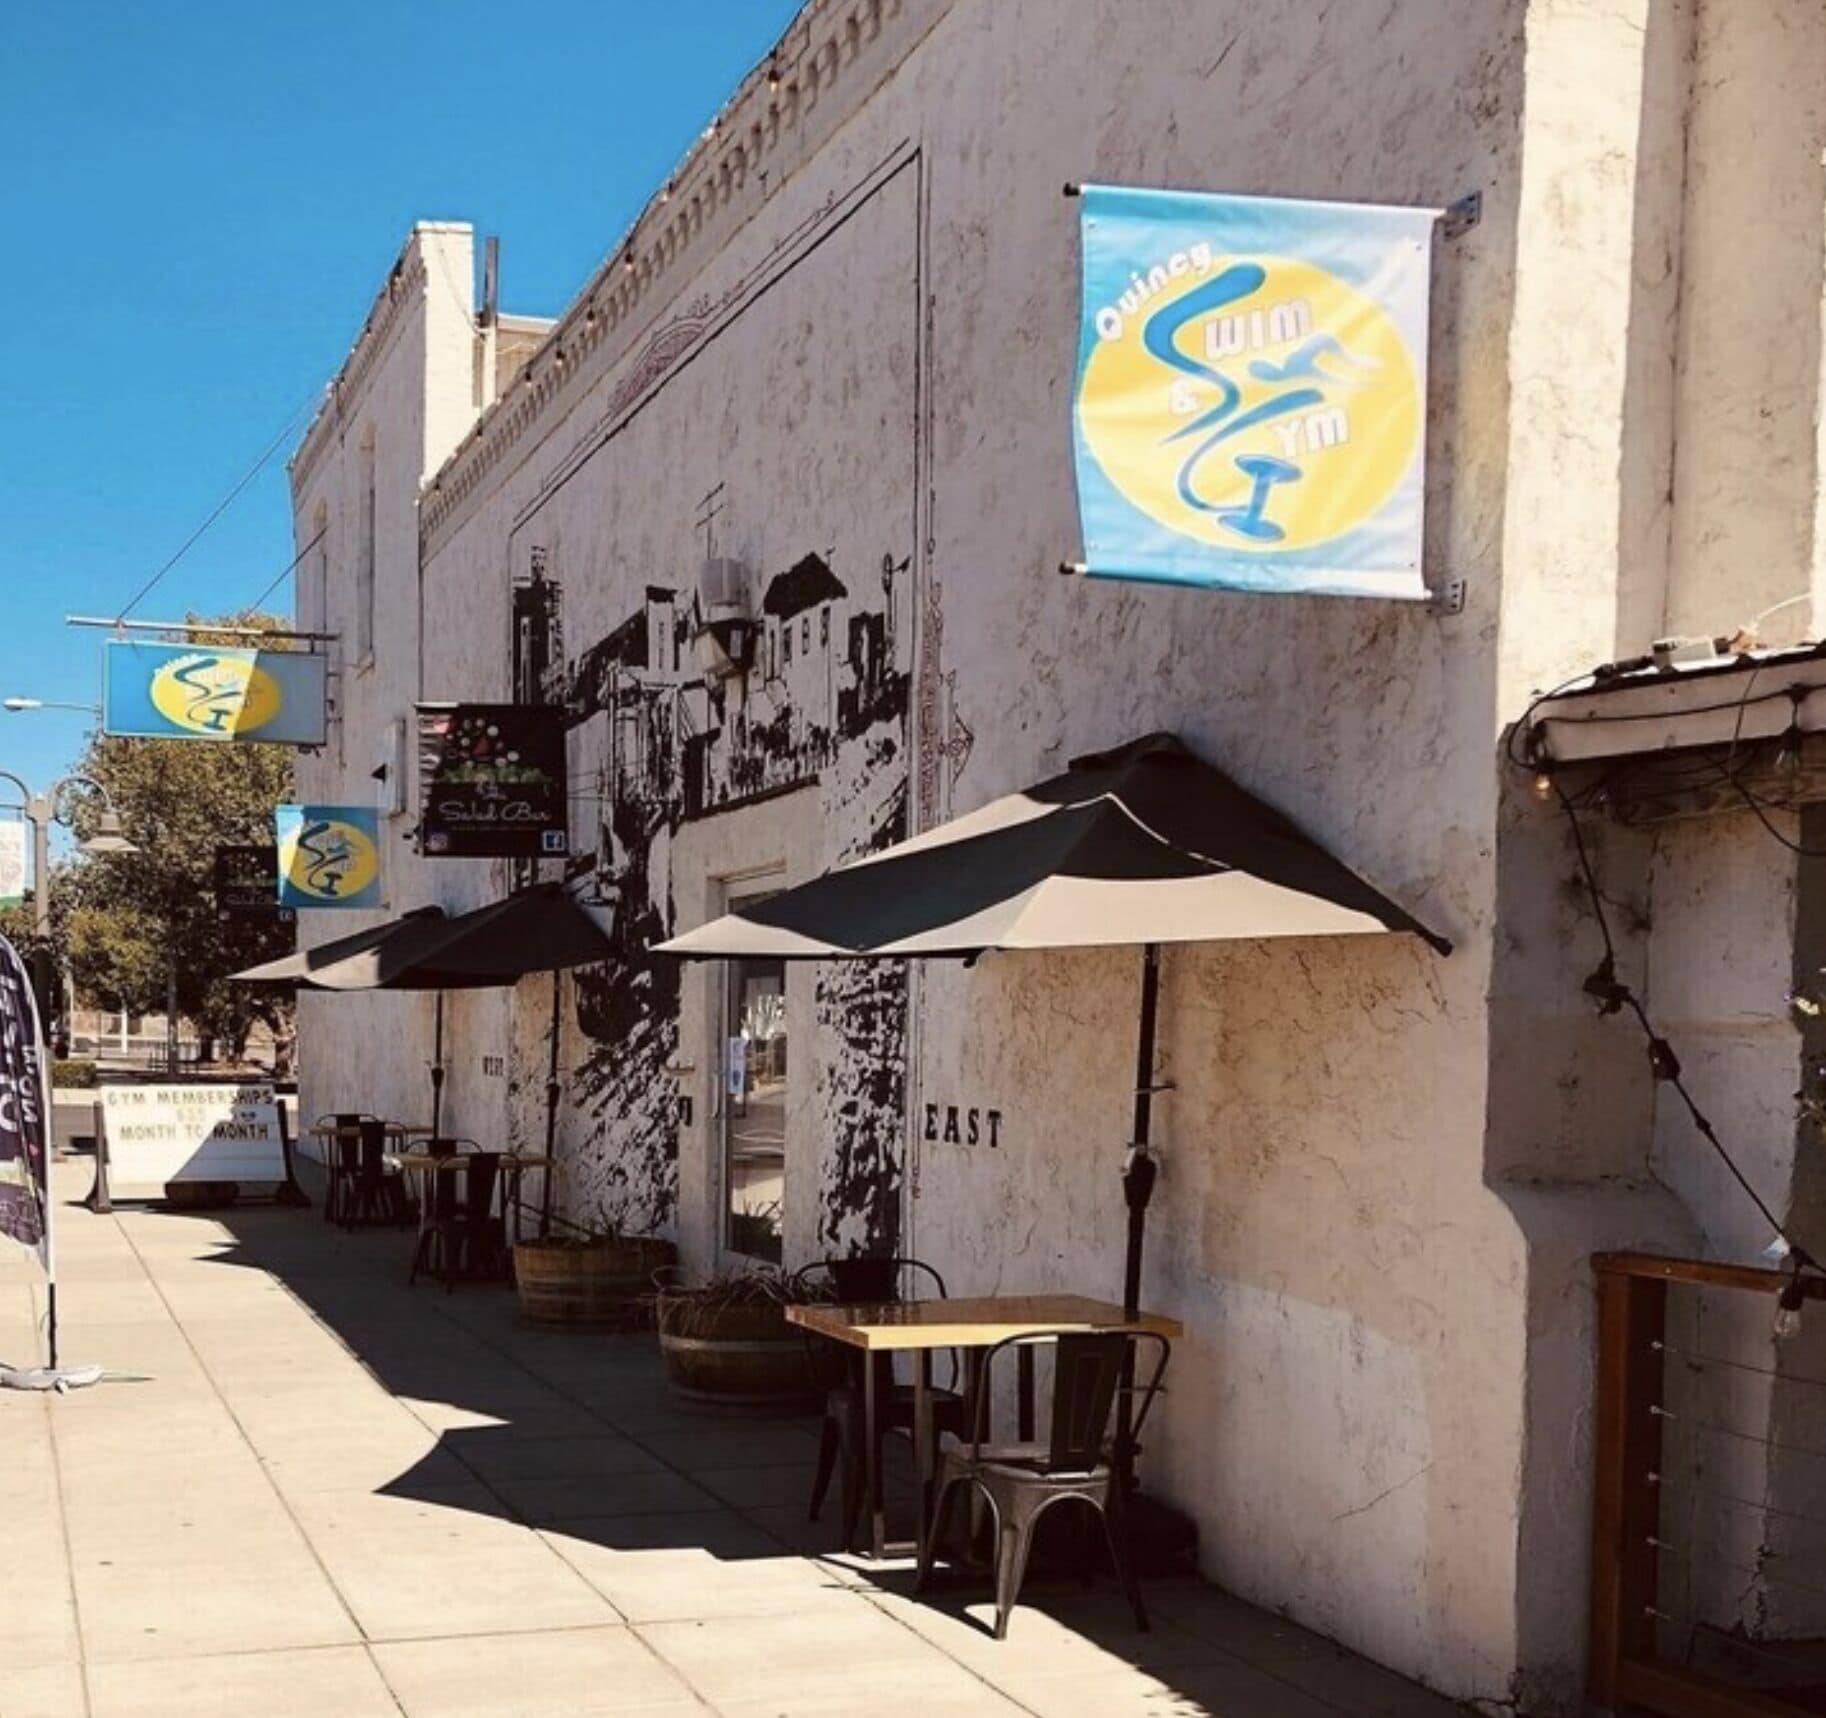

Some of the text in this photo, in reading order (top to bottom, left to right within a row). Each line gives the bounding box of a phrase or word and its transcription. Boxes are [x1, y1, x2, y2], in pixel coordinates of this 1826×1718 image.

[1096, 242, 1212, 341] Quincy
[108, 1088, 273, 1105] GYM MEMBERSHIPS
[120, 1122, 269, 1140] MONTH TO MONTH
[925, 1103, 1002, 1148] EAST
